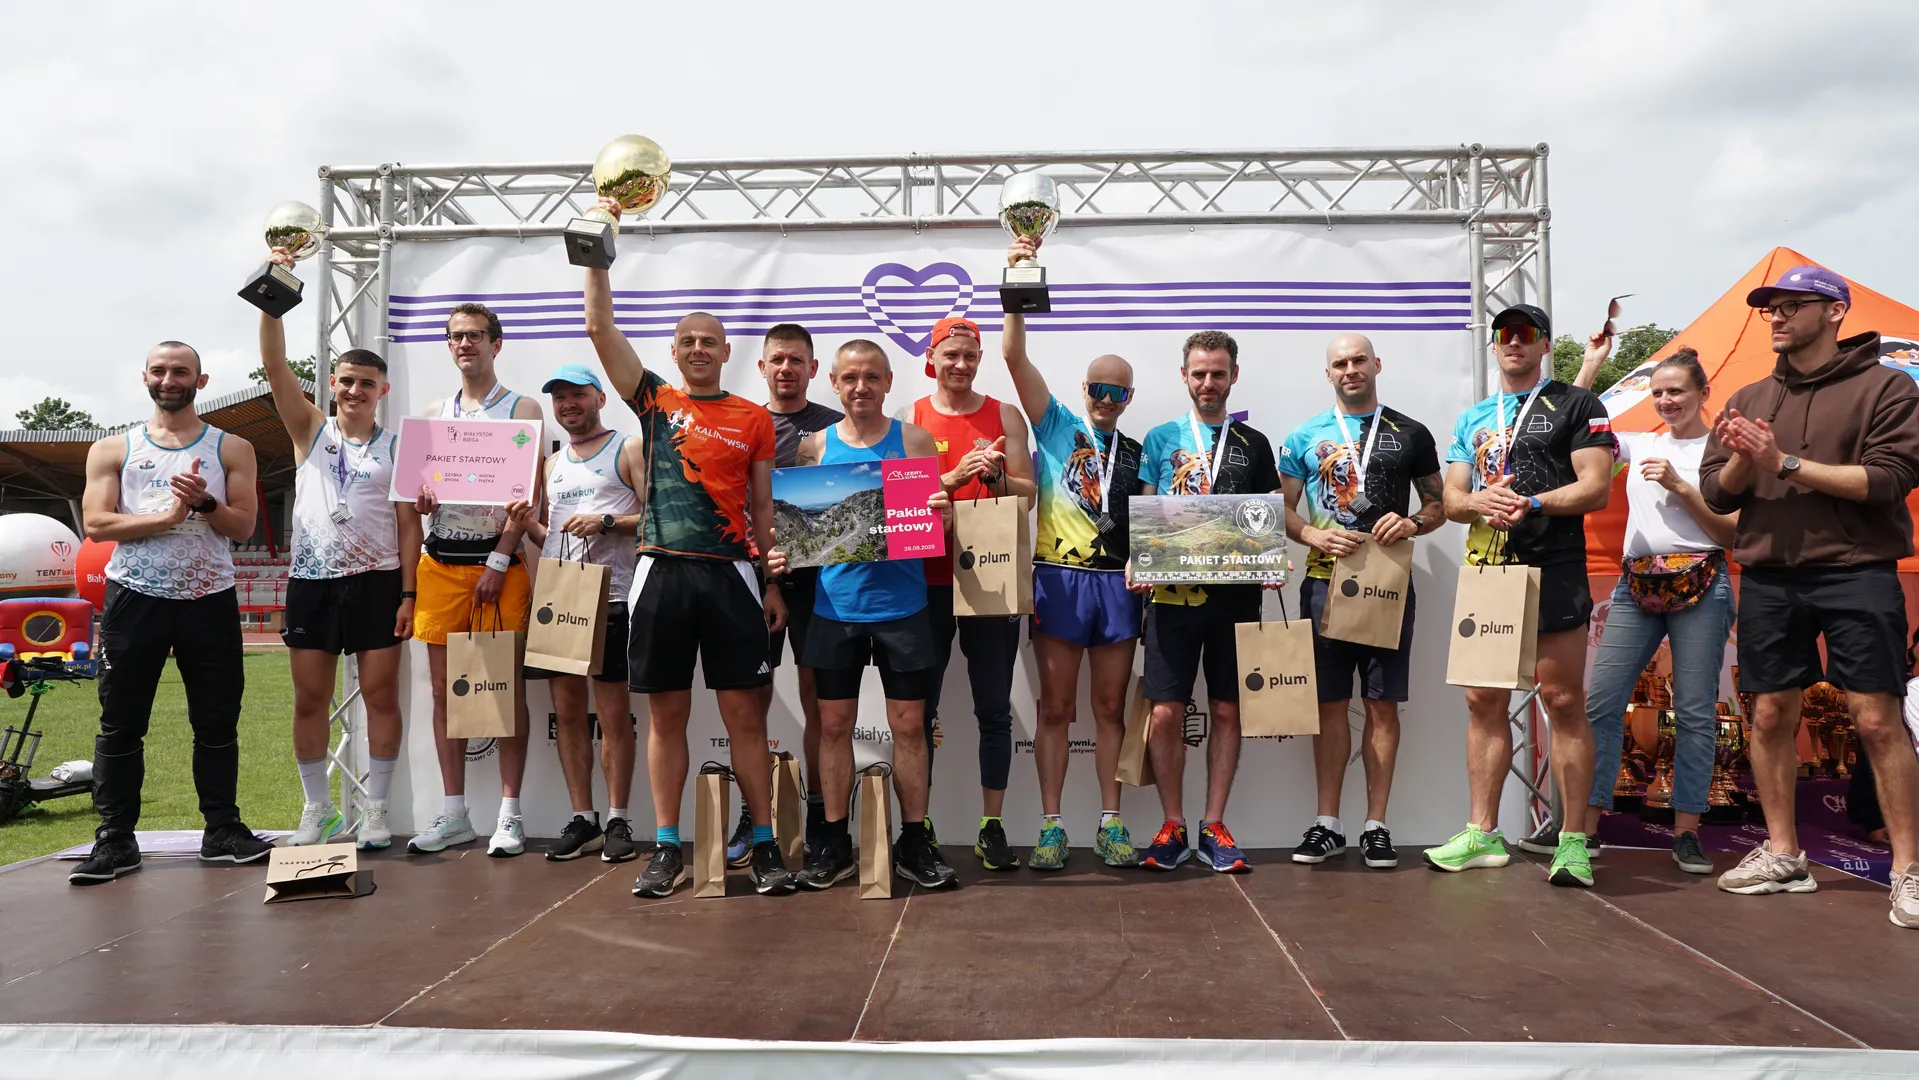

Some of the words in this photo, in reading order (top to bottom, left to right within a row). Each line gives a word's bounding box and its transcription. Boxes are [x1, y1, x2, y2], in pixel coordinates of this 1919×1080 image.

[798, 428, 813, 436] Ave
[426, 454, 457, 463] PAKIET
[459, 456, 507, 464] STARTOWY
[150, 480, 169, 488] TEA
[1244, 499, 1266, 508] BISON
[886, 506, 933, 519] Pakiet
[869, 522, 933, 535] startowy
[979, 551, 1010, 568] plum
[1180, 555, 1220, 565] PAKIET
[1222, 554, 1283, 565] STARTOWY
[36, 569, 76, 577] TENTbal
[87, 573, 107, 585] Biały
[1363, 585, 1400, 601] plum
[557, 612, 590, 627] plum
[1480, 621, 1514, 637] plum
[474, 680, 508, 694] plum
[1269, 673, 1308, 689] plum
[852, 726, 892, 744] Białys
[486, 749, 495, 757] OD
